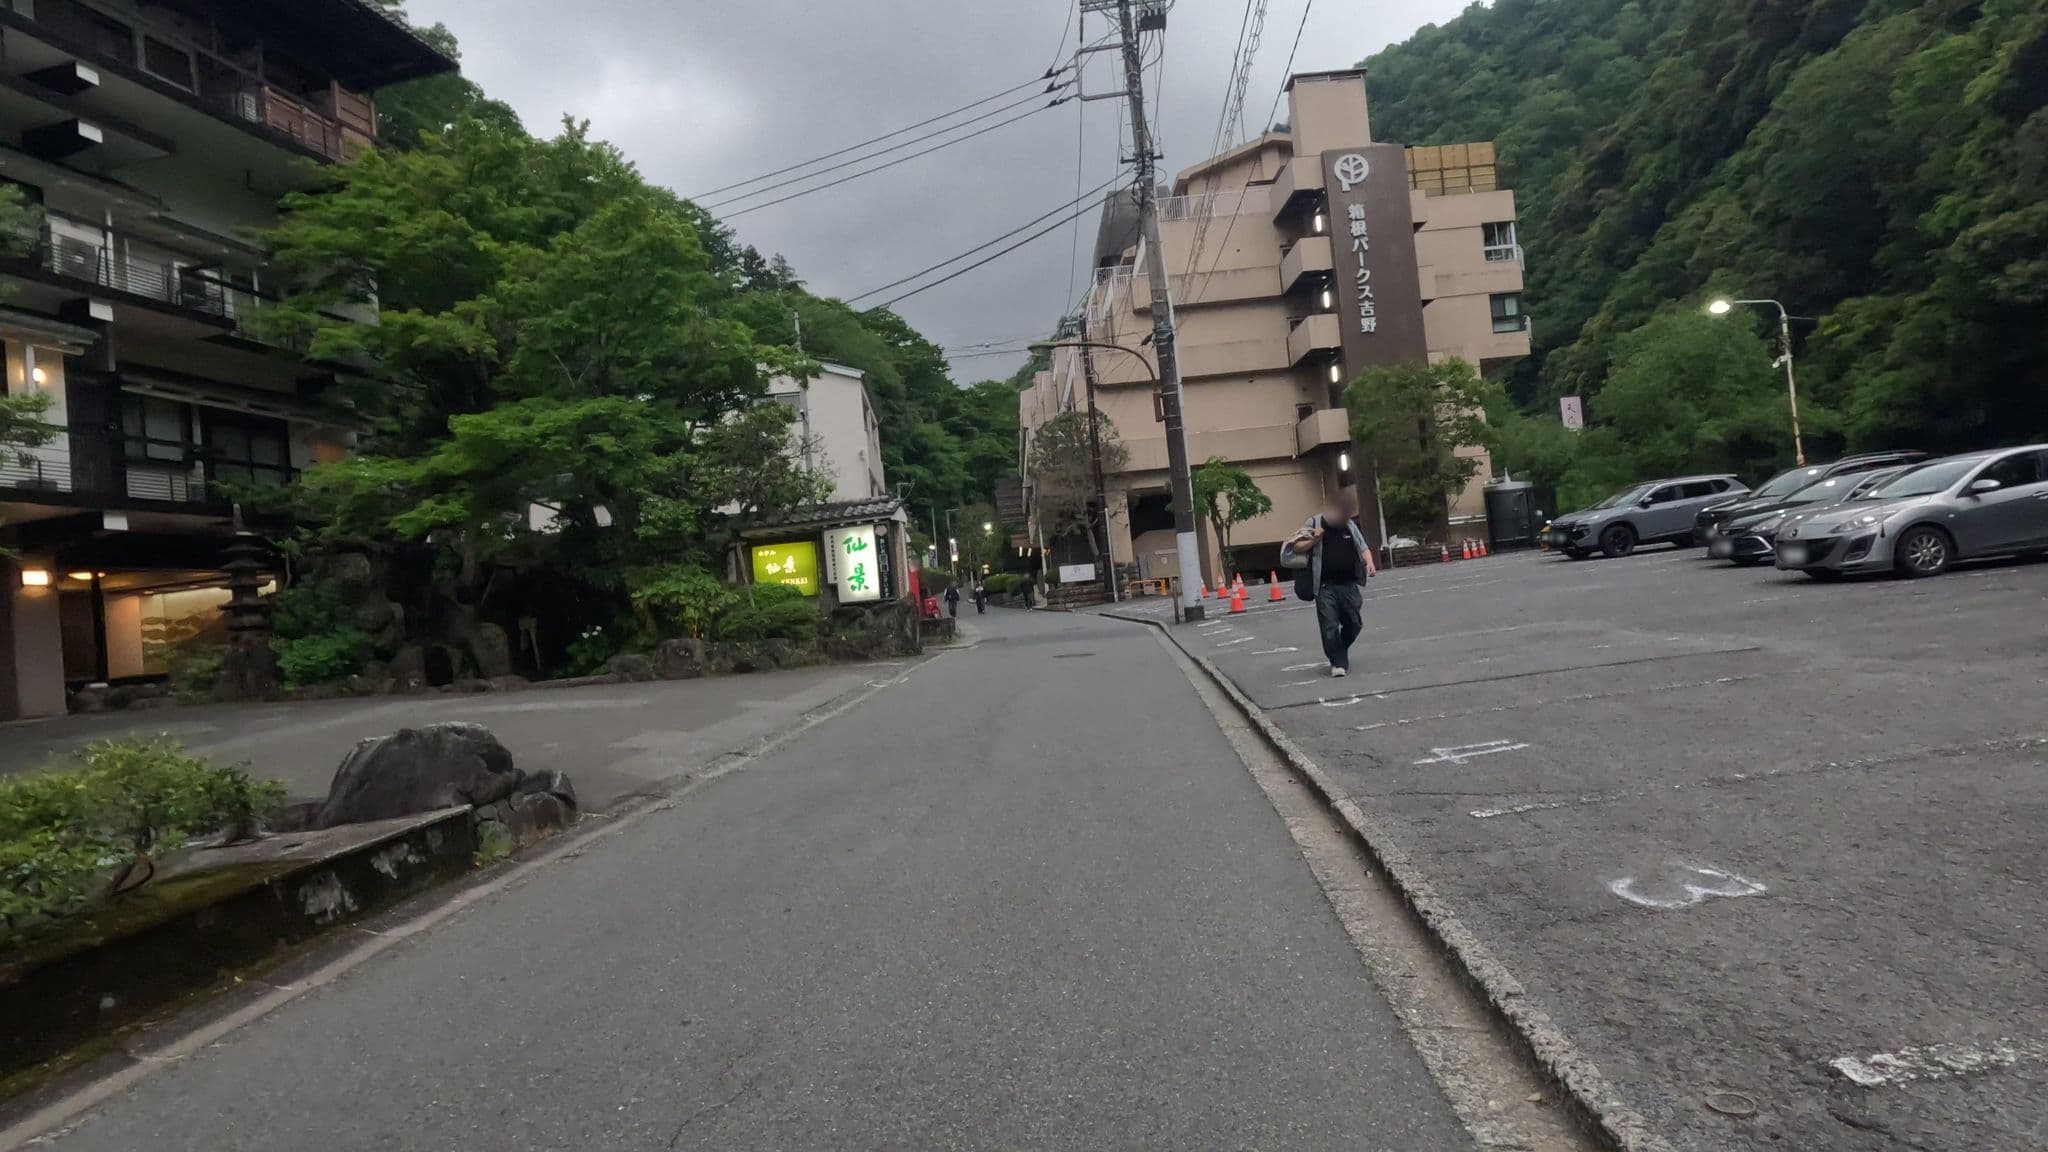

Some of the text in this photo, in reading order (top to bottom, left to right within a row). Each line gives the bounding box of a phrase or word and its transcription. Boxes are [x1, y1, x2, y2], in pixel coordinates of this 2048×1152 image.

[1347, 203, 1377, 334] 箱根パークス吉野
[842, 536, 870, 592] 仙景
